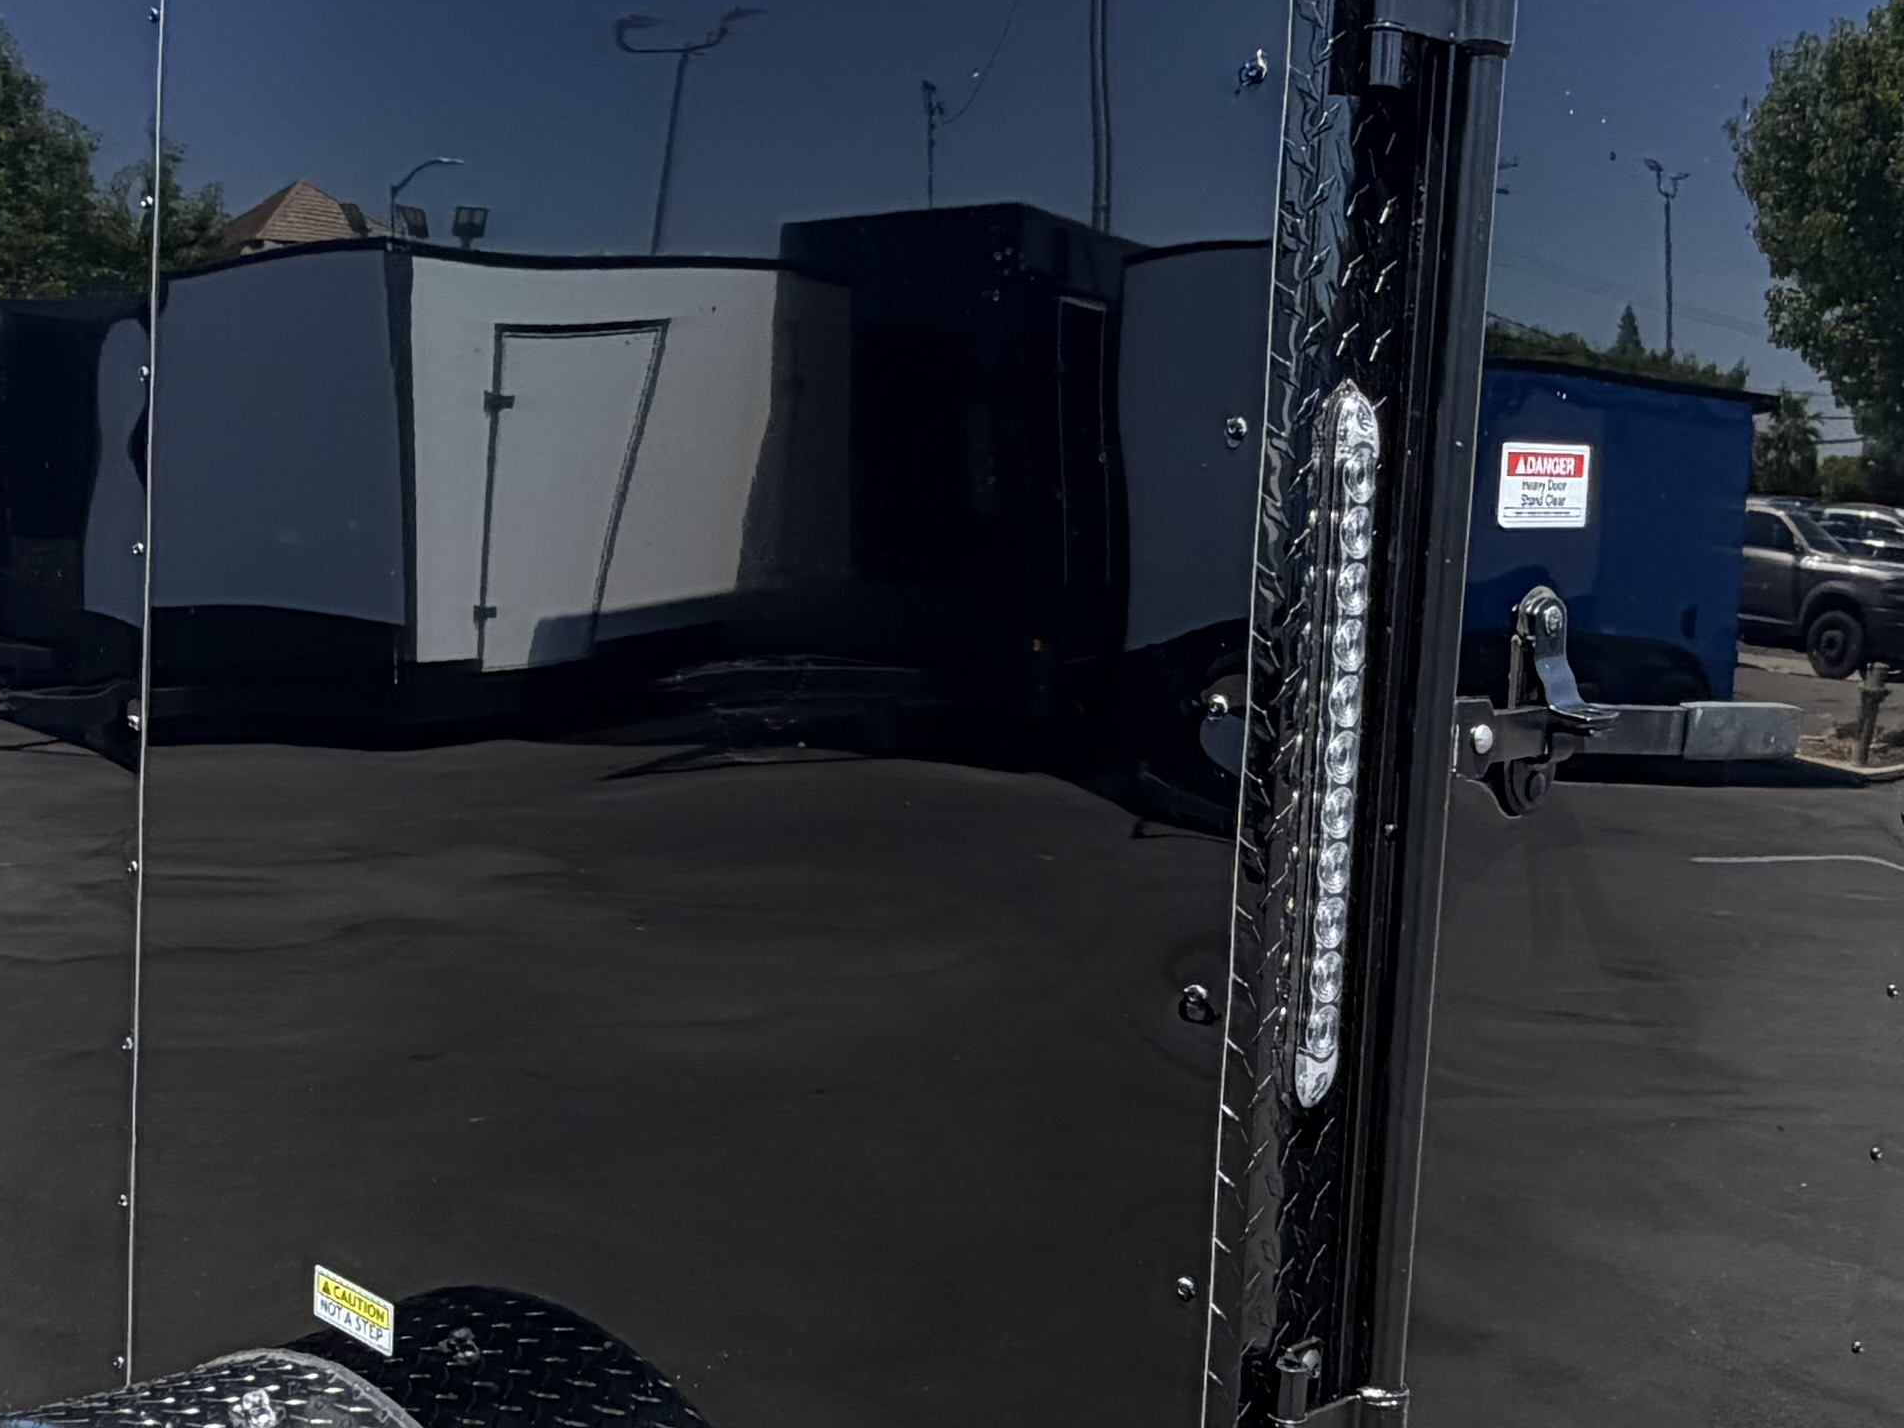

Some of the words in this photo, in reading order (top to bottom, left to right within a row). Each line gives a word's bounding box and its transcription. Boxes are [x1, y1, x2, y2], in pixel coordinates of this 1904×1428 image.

[1525, 455, 1576, 476] DANGER
[1547, 479, 1567, 492] Door
[333, 1285, 385, 1323] CAUTION
[320, 1299, 343, 1320] NOT
[343, 1311, 353, 1327] A
[354, 1316, 383, 1342] STEP
